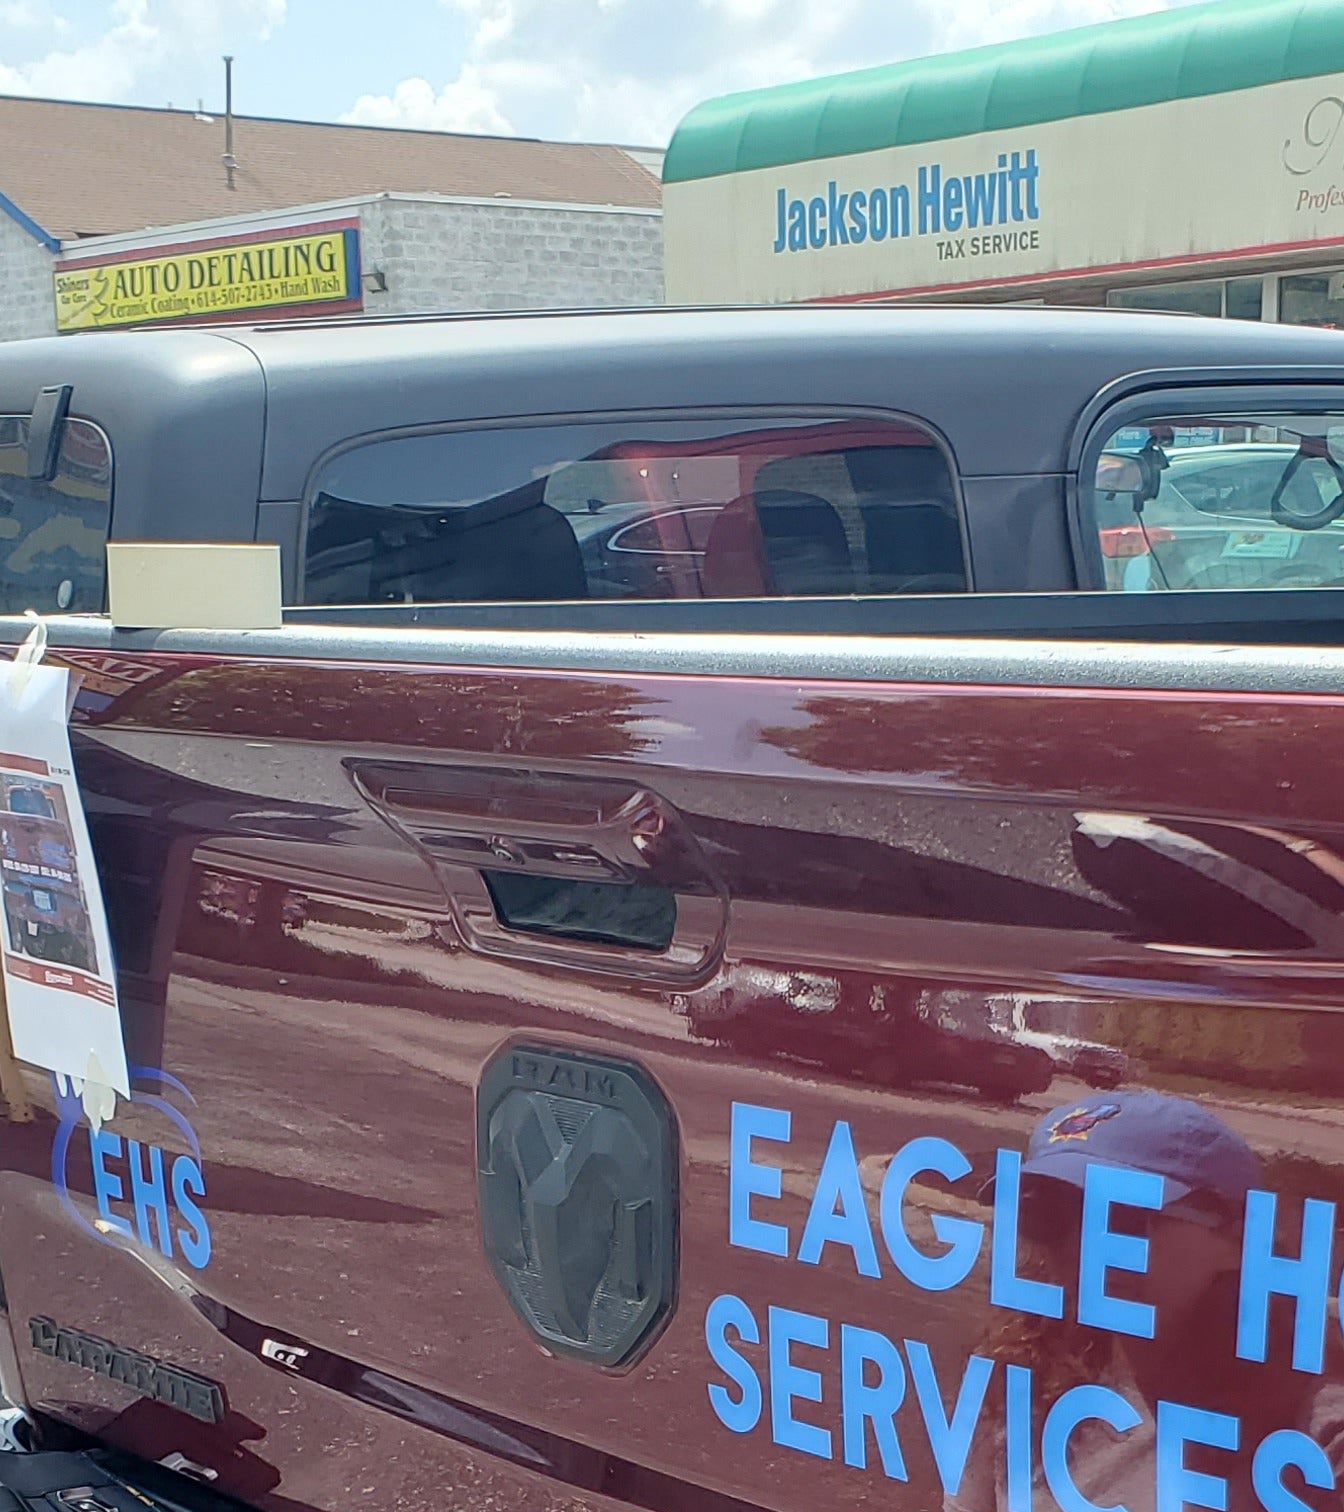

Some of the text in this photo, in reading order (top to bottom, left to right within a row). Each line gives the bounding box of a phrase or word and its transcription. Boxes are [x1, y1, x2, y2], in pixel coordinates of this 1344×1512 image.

[773, 149, 1040, 254] Jackson Hewitt
[113, 240, 337, 300] AUTO DETAILING
[936, 230, 1040, 262] TAX SERVICE
[110, 298, 150, 319] Ceramic
[150, 293, 191, 315] Coating
[279, 278, 309, 298] Hand
[311, 275, 341, 295] Wash
[88, 1127, 213, 1270] EHS
[729, 1101, 1164, 1339] EAGLE
